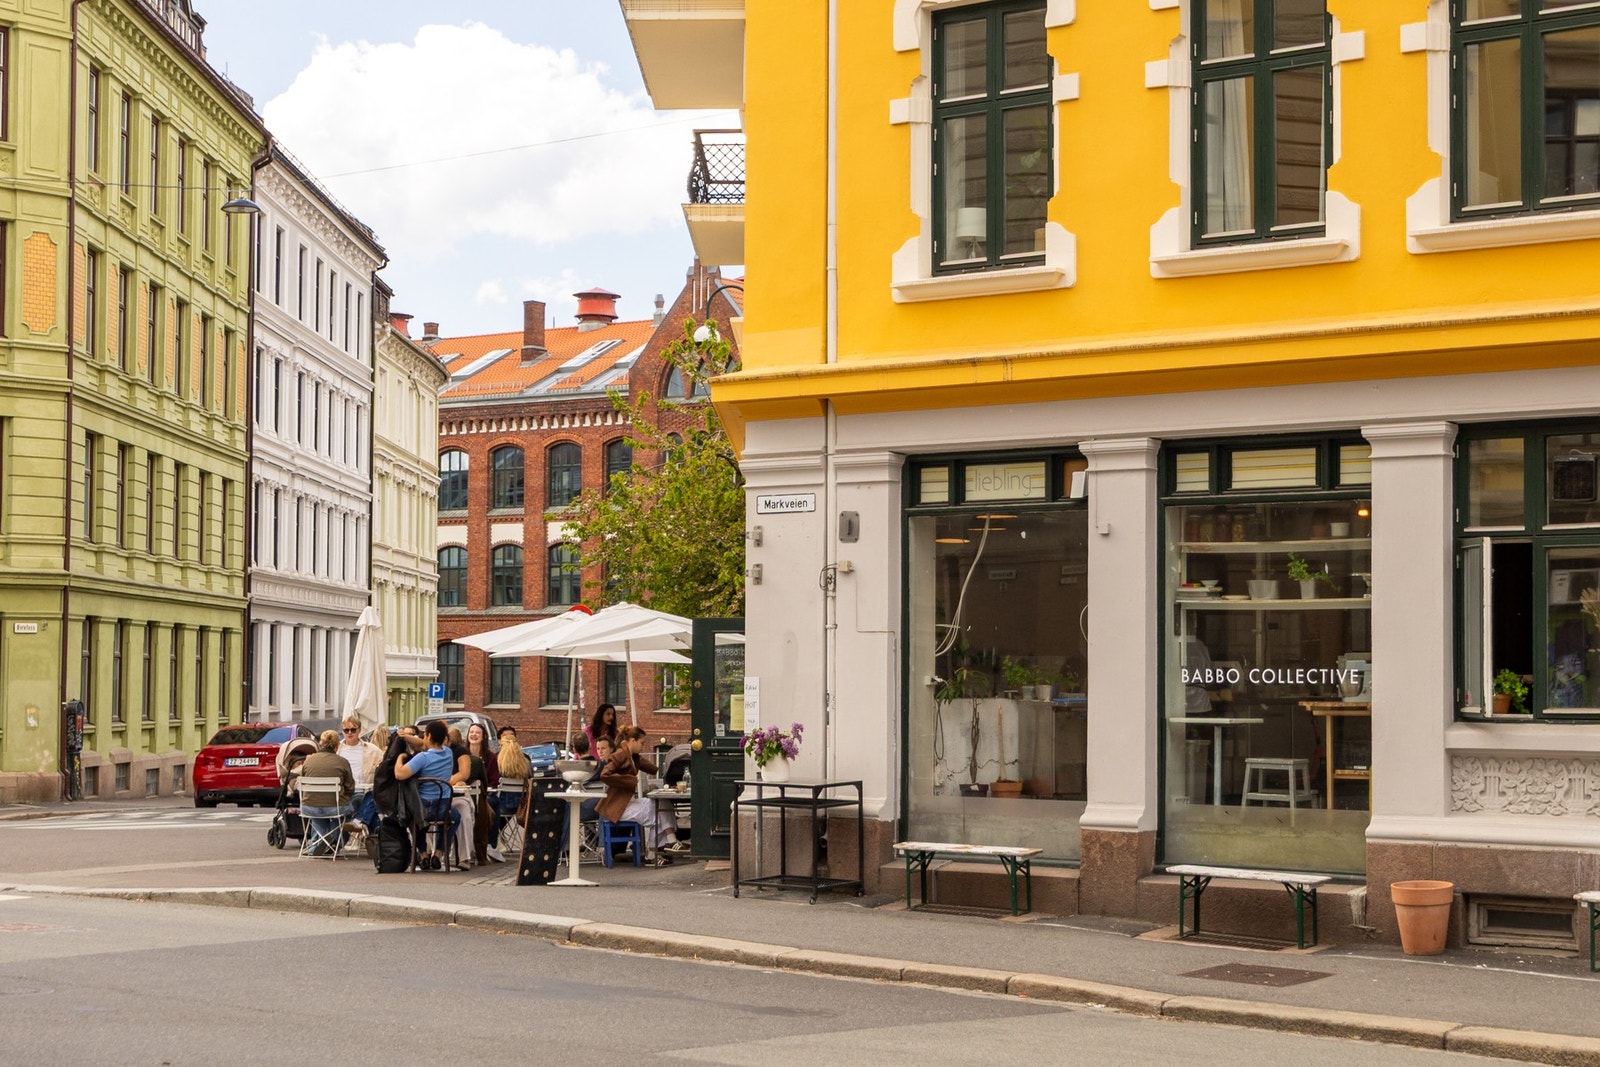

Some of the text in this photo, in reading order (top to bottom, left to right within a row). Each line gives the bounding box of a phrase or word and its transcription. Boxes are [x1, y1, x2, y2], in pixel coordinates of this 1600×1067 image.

[975, 468, 1031, 496] liebling
[764, 499, 808, 509] Markveien
[1181, 668, 1359, 684] BABBO COLLECTIVE
[432, 685, 441, 696] P
